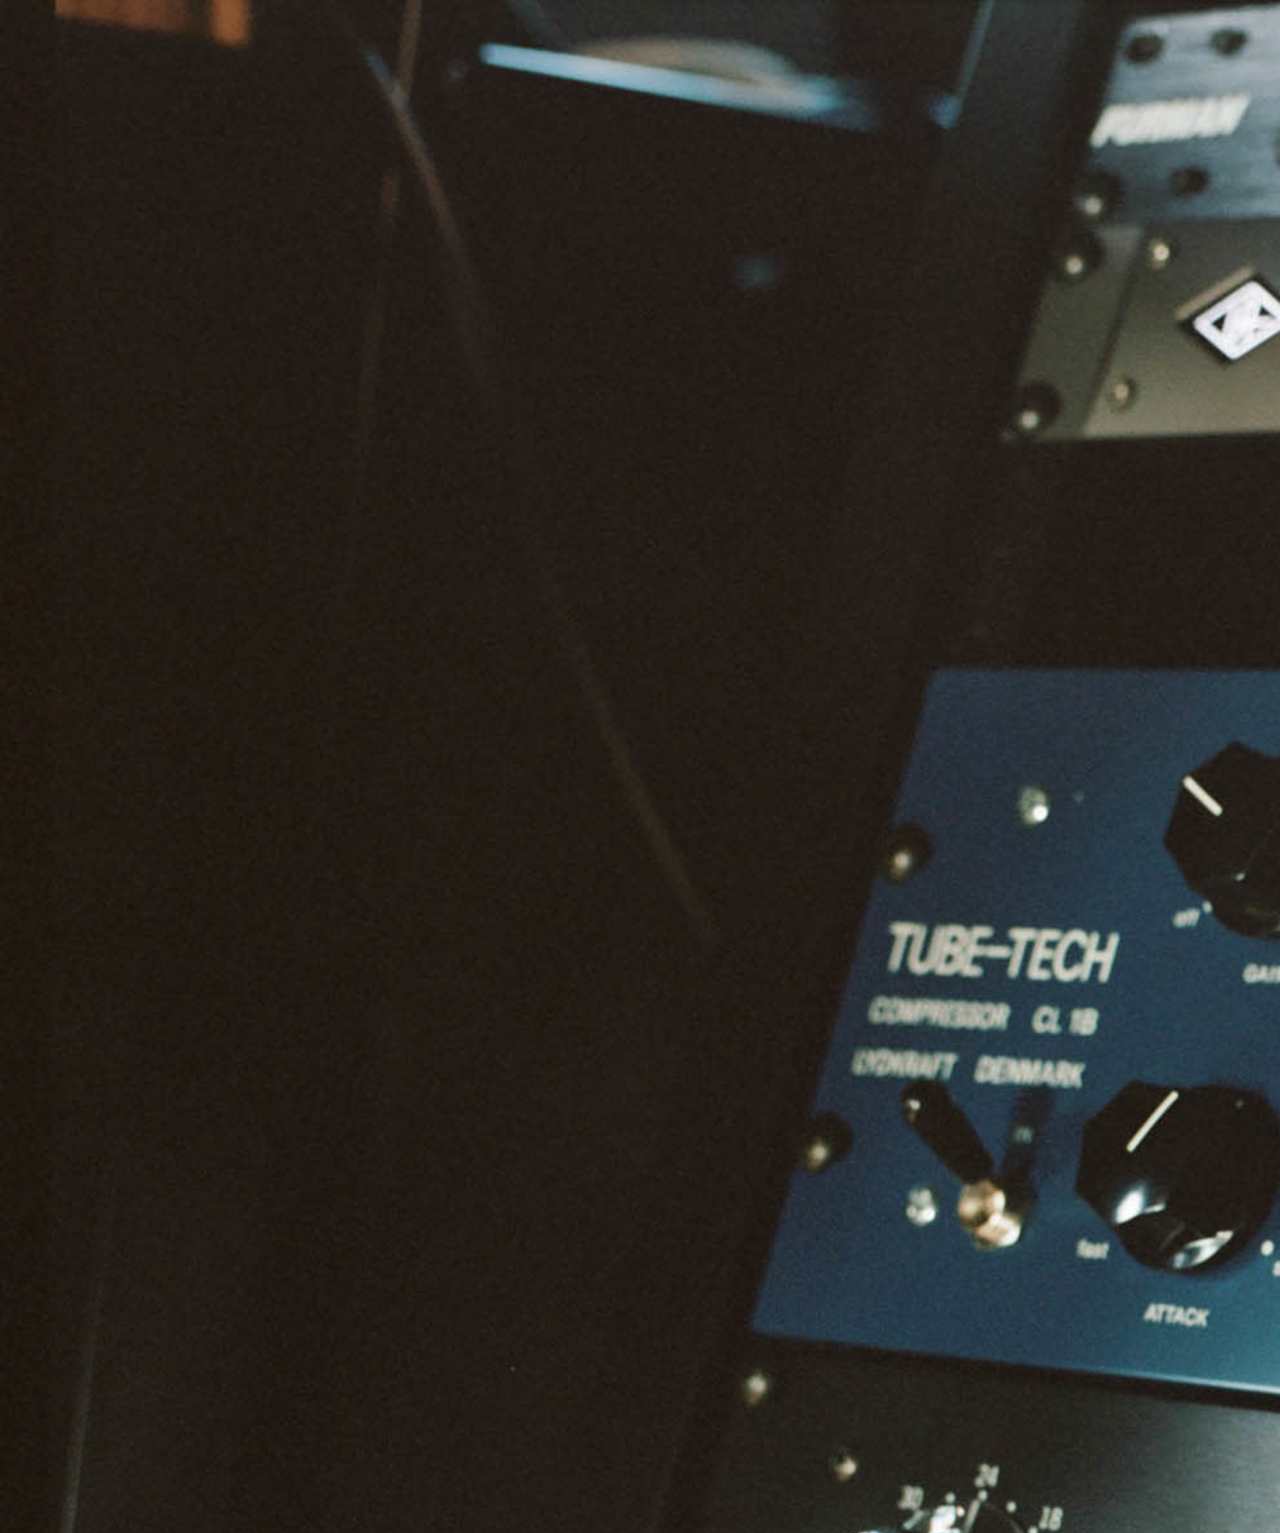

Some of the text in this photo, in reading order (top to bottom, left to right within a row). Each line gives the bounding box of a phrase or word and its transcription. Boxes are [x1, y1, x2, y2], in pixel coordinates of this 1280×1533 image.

[887, 921, 1120, 985] TUBE-TECH
[1030, 1006, 1062, 1034] CL
[973, 1055, 1087, 1089] DENMARK
[1143, 1302, 1210, 1328] ATTACK
